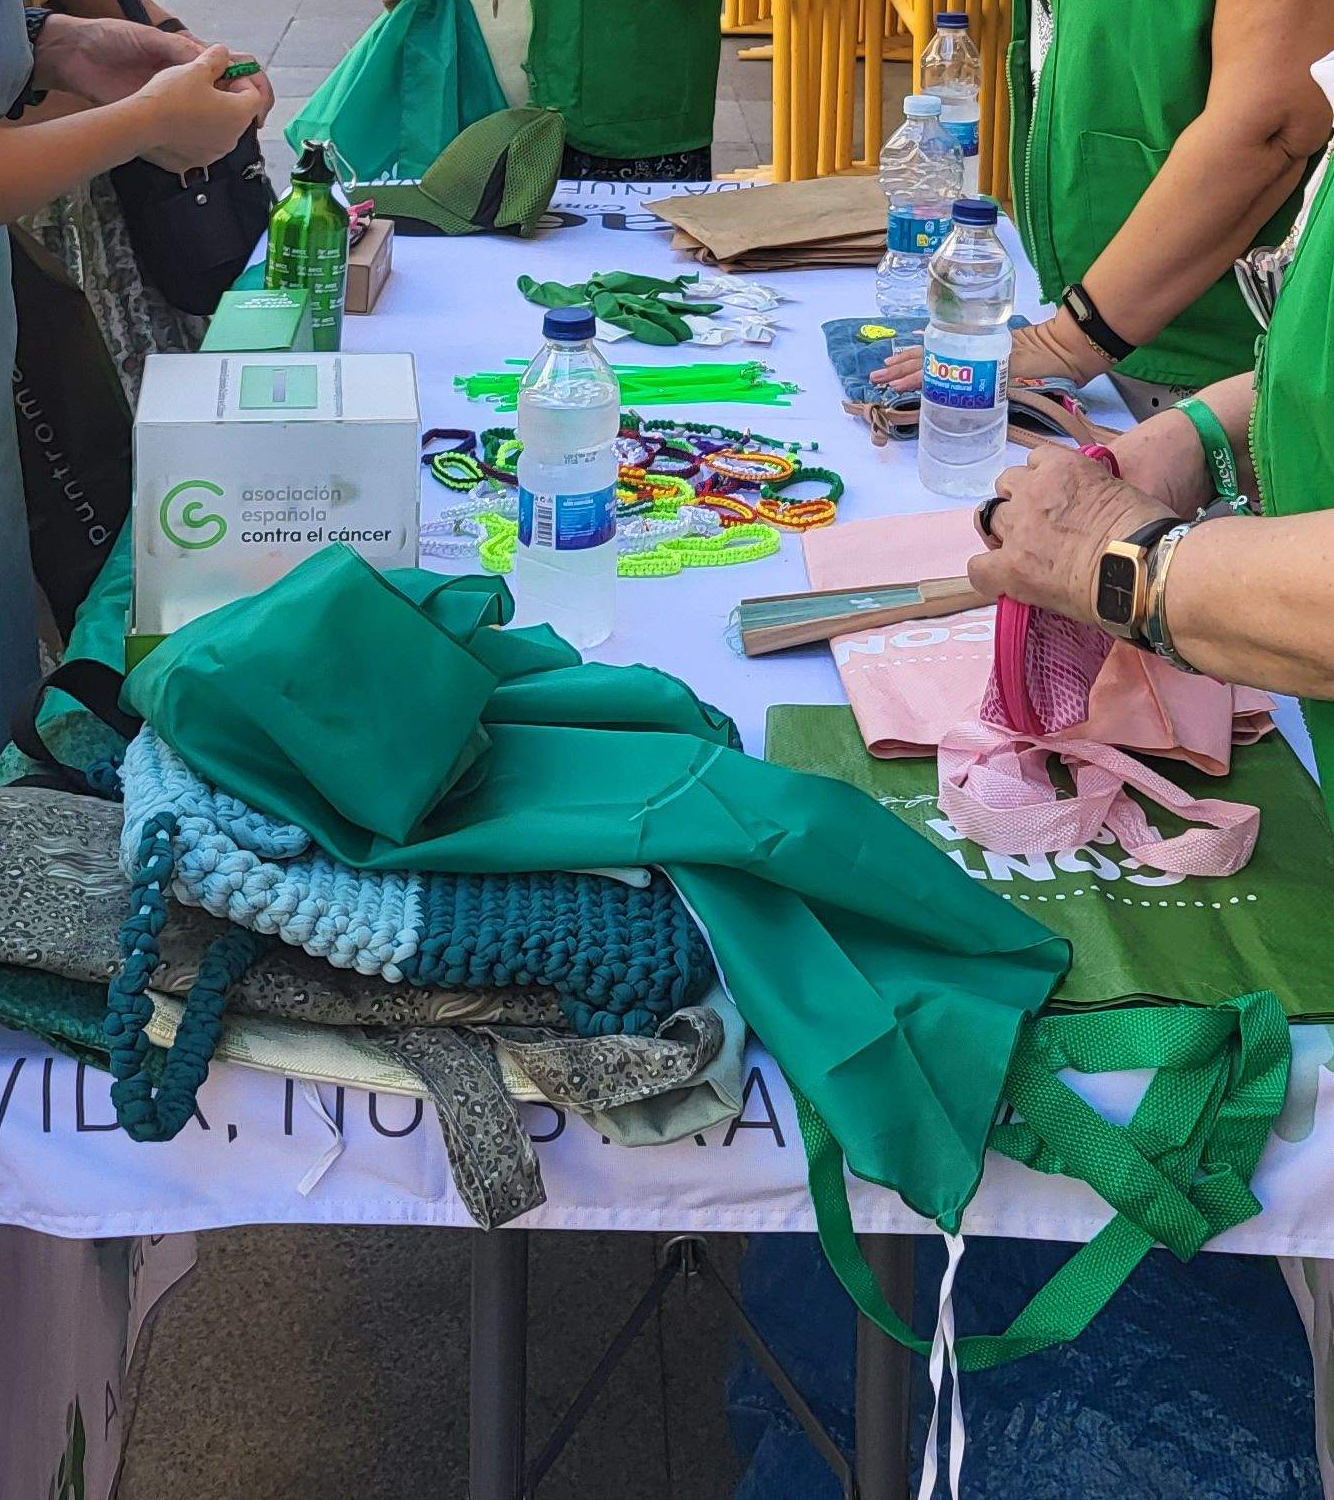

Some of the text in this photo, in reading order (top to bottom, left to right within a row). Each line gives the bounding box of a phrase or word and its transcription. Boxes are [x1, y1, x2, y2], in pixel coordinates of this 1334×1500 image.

[241, 485, 342, 502] asociación
[241, 506, 328, 526] española
[241, 526, 392, 543] contra el cáncer
